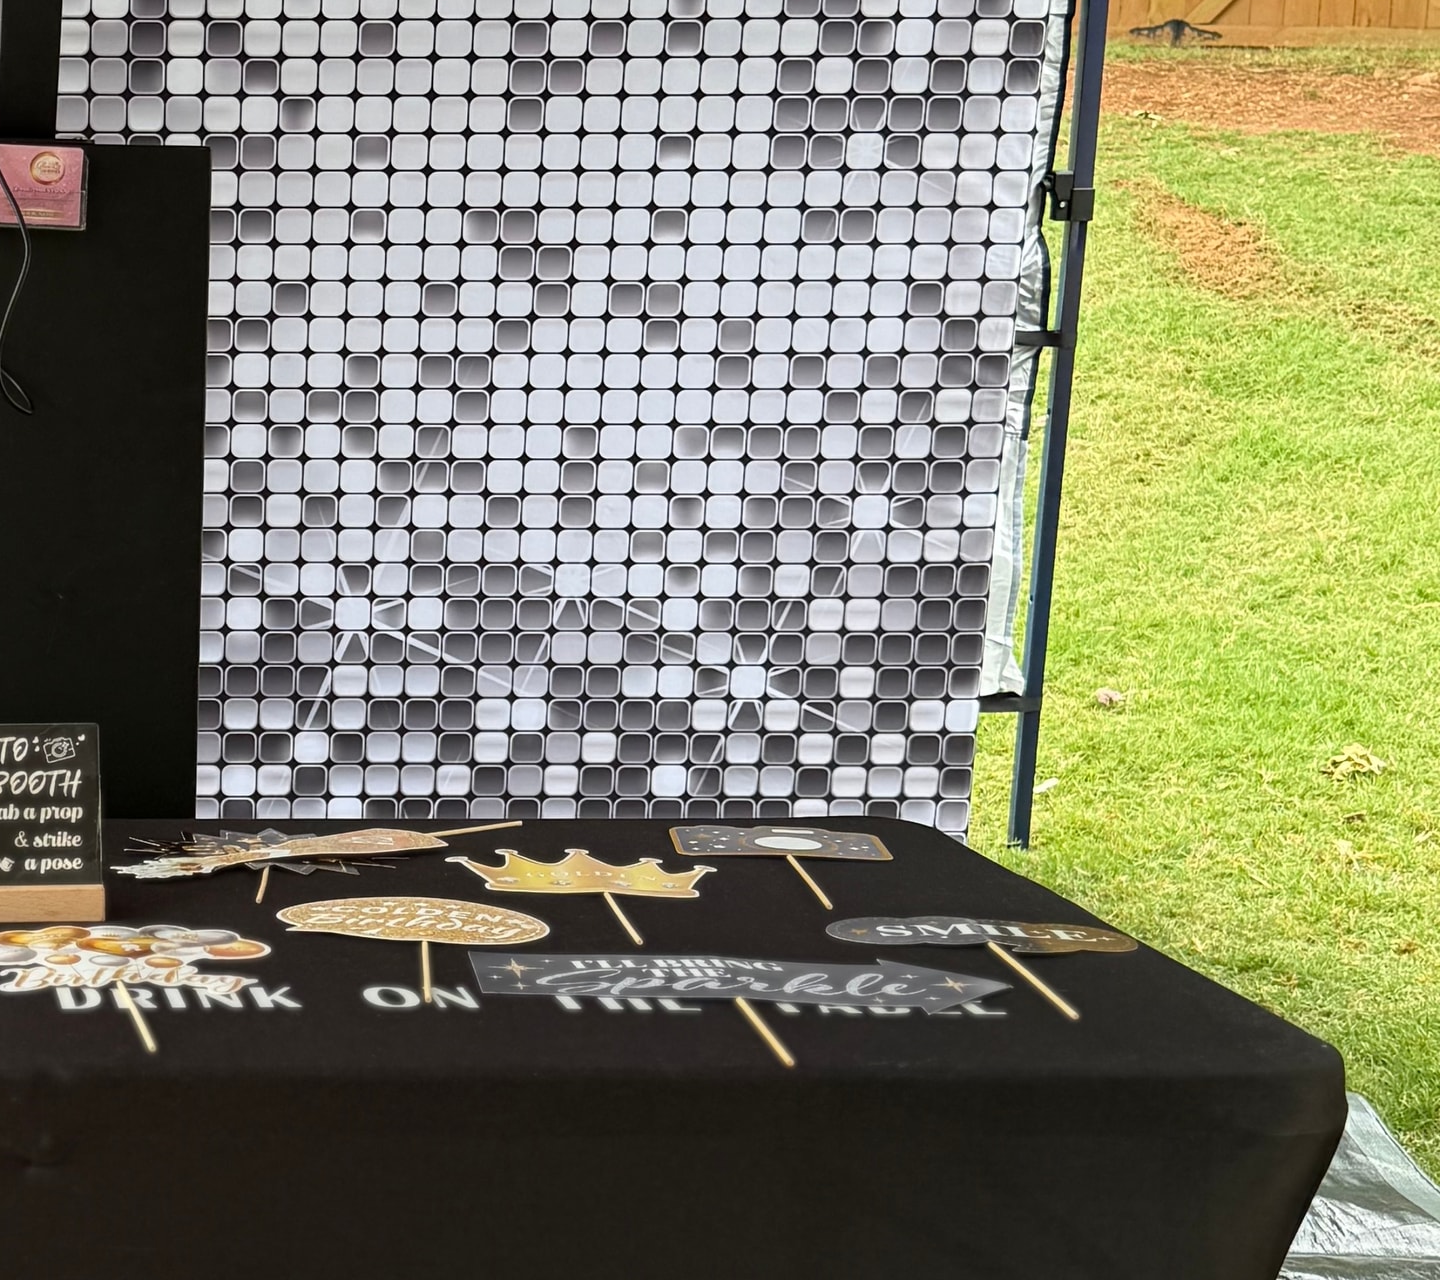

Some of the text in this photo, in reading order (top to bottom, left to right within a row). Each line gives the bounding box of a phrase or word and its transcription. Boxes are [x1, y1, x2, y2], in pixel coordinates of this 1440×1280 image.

[23, 809, 38, 820] a
[39, 807, 84, 824] prop
[14, 831, 84, 847] & strike
[24, 857, 84, 874] a pose
[876, 923, 1098, 942] SMILE
[641, 967, 731, 978] THE
[652, 959, 784, 972] BRING
[5, 967, 250, 994] Birthday
[536, 969, 927, 996] Sparkle
[56, 986, 303, 1010] DRINK
[363, 986, 480, 1009] ON
